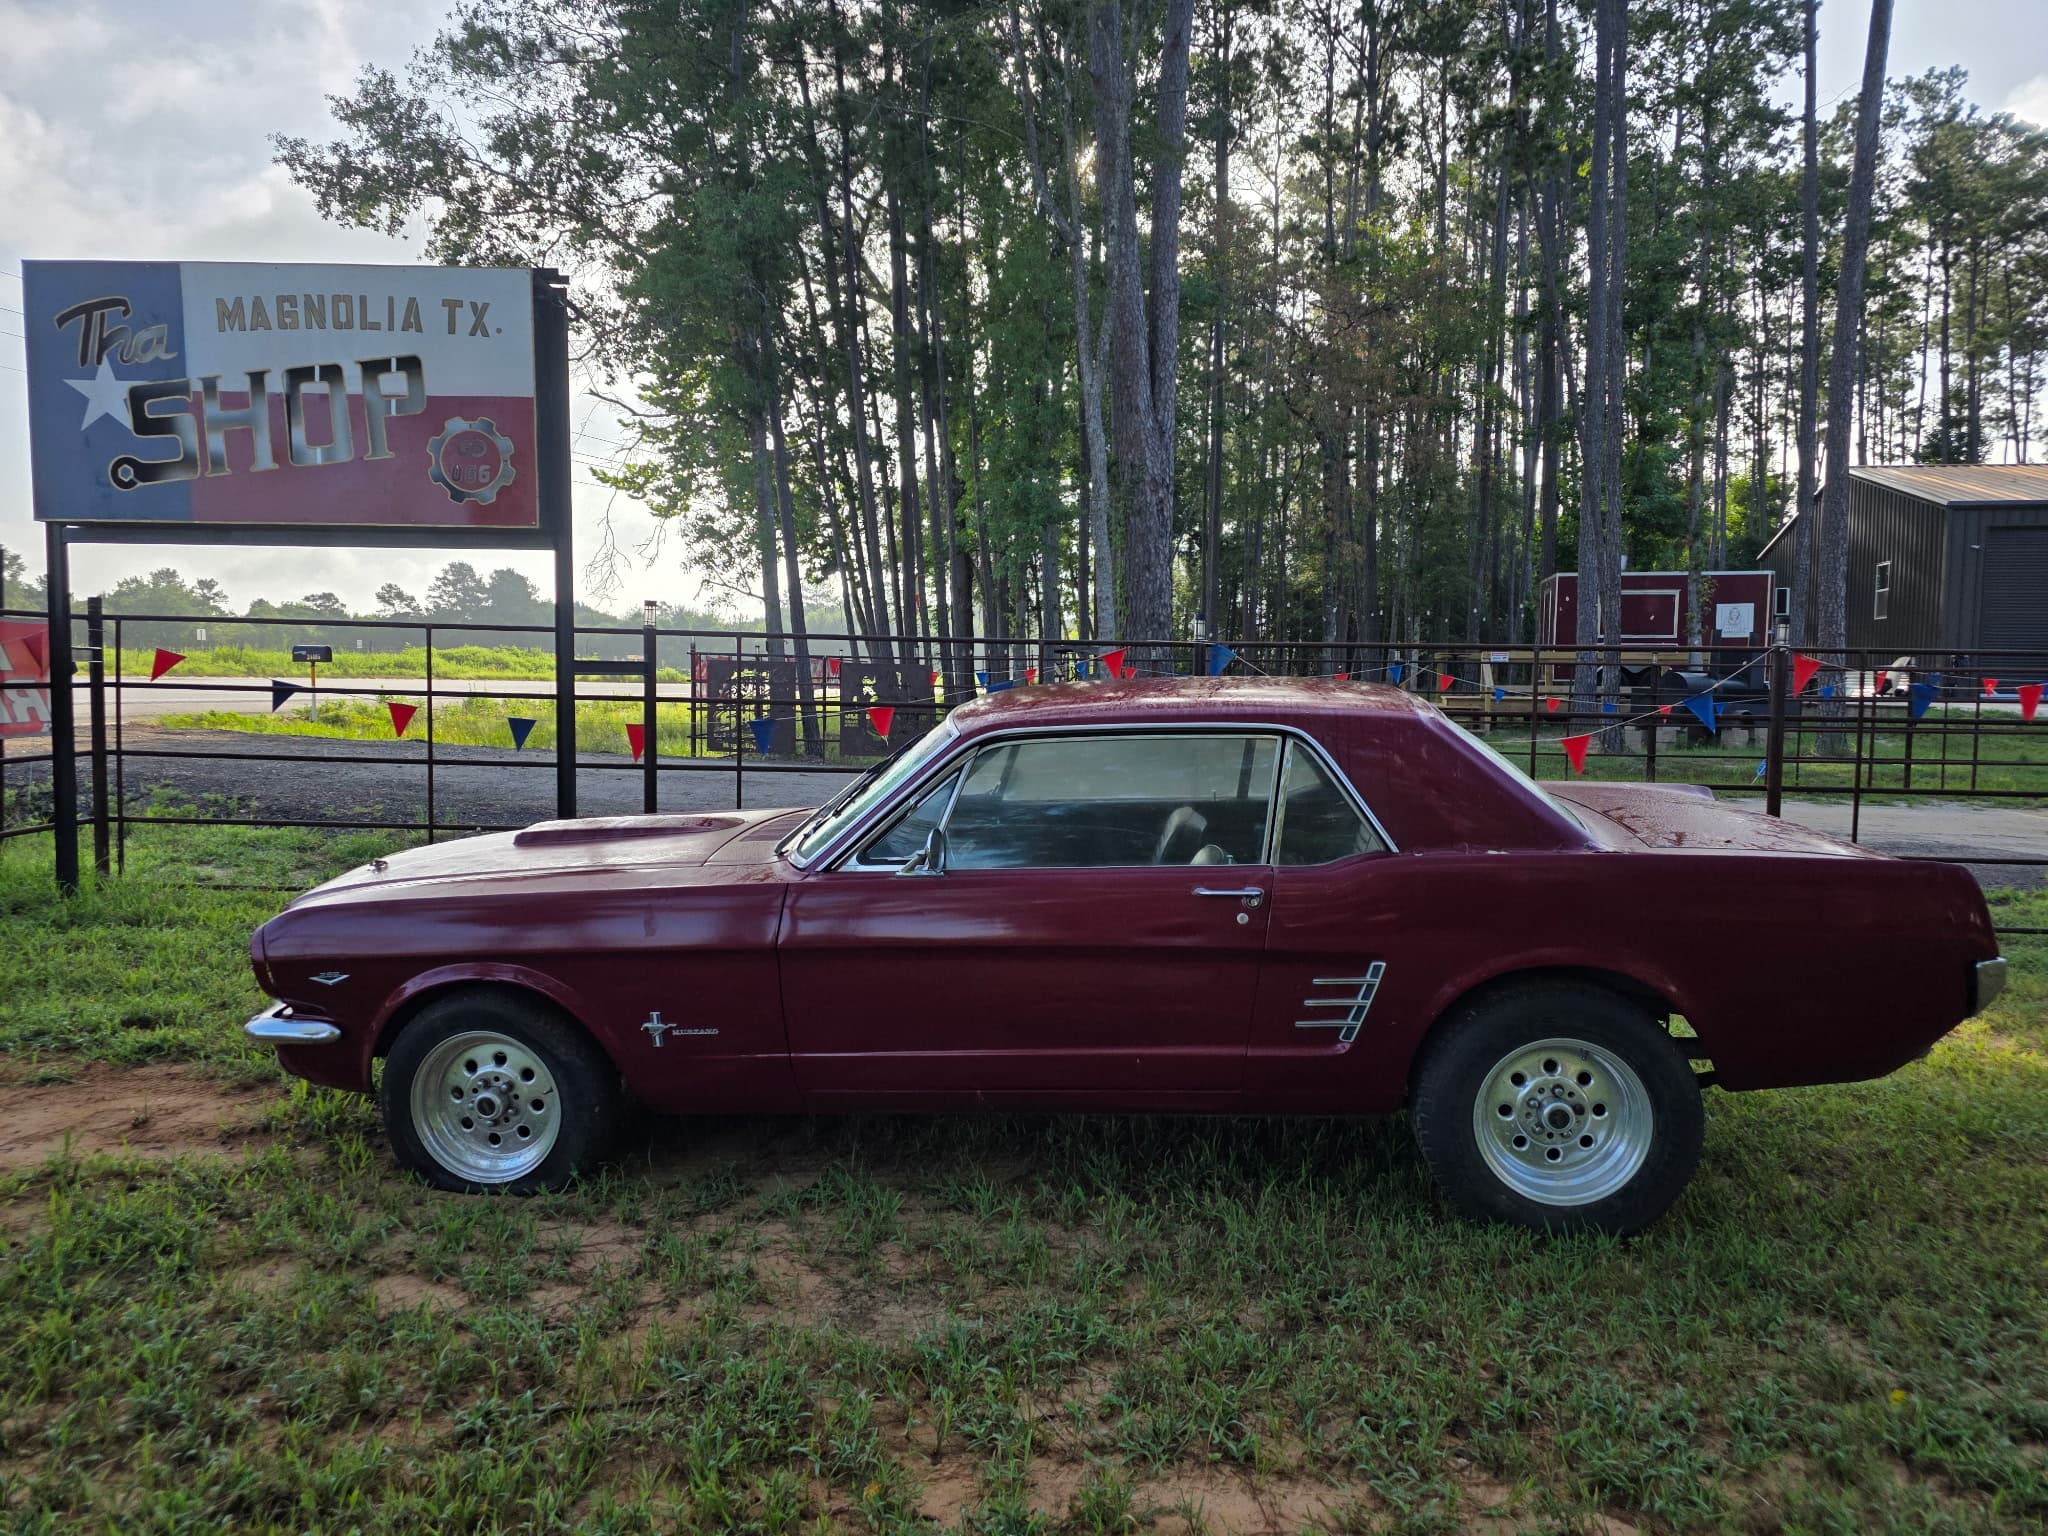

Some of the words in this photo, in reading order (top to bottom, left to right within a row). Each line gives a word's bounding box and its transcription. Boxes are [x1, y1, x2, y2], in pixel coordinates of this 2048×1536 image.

[54, 295, 179, 368] Tha
[215, 294, 424, 333] MAGNOLIA
[441, 298, 503, 338] TX.
[108, 354, 427, 491] SHOP
